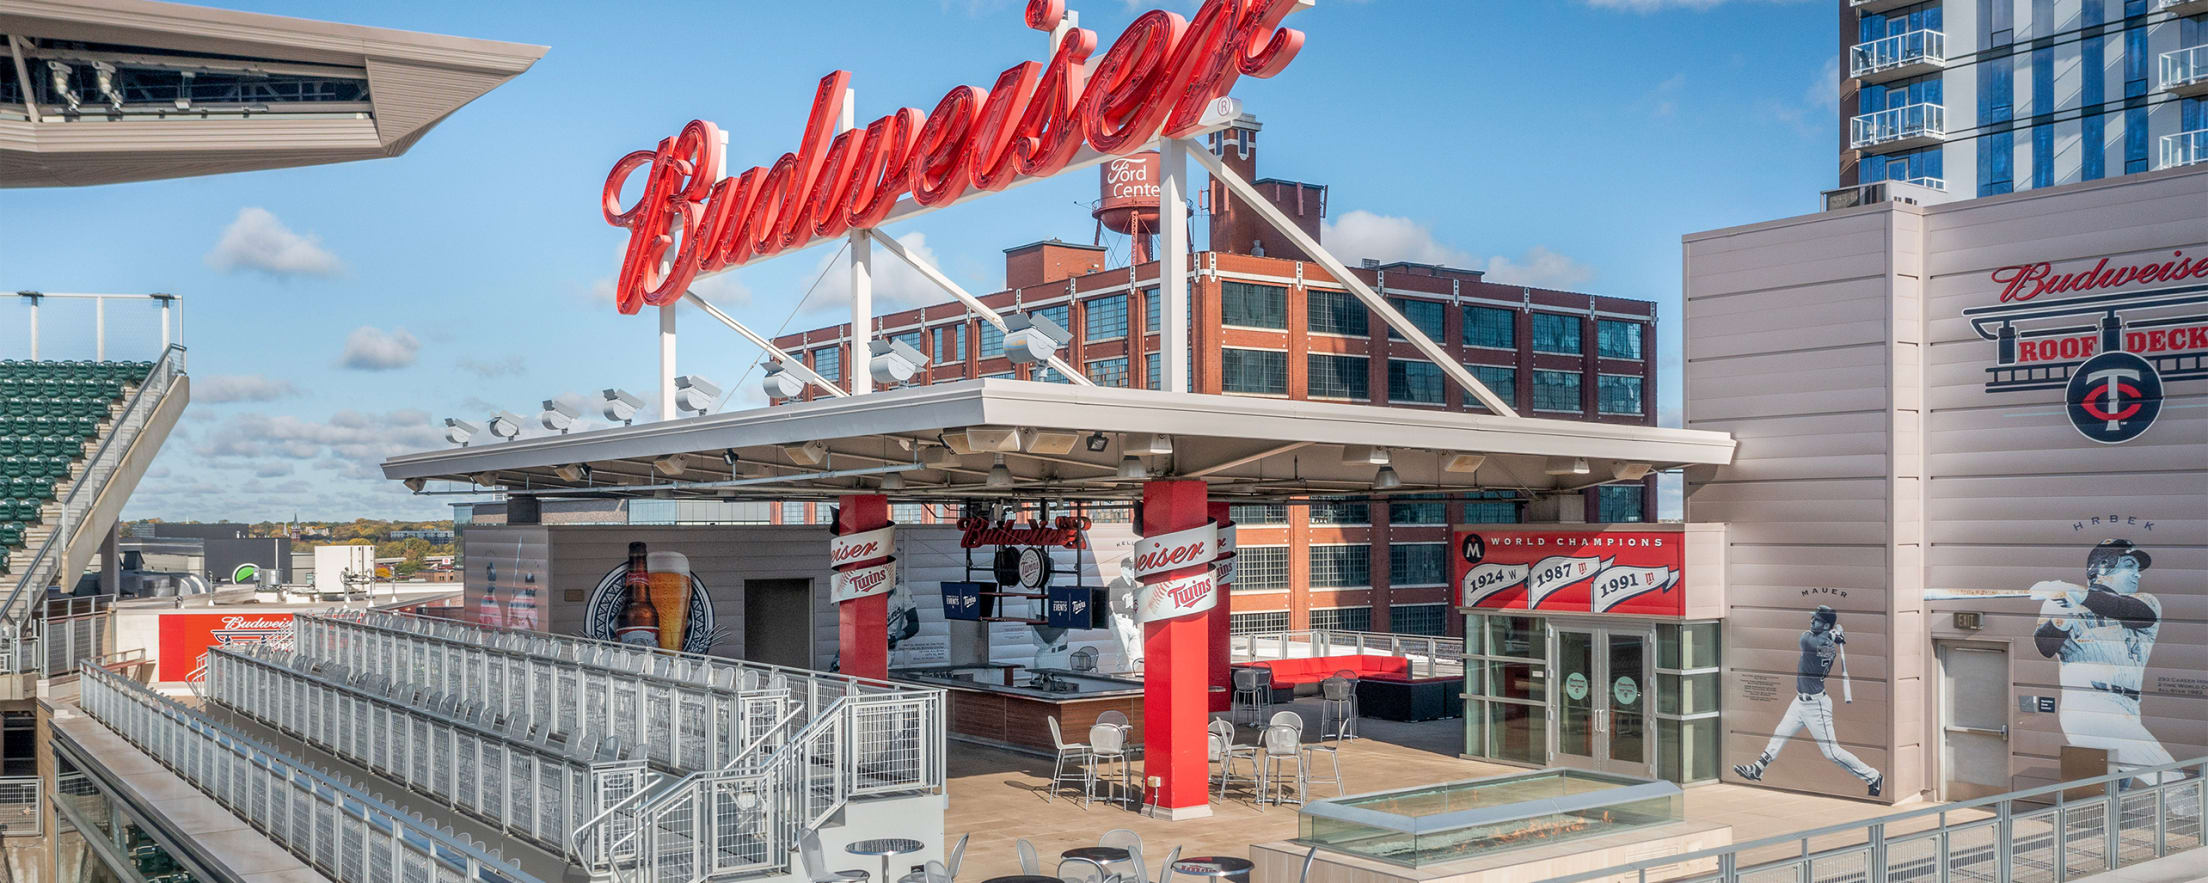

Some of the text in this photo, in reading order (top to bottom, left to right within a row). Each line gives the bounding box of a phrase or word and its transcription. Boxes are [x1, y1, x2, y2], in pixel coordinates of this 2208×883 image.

[602, 0, 1305, 314] Budweiser
[1108, 158, 1147, 184] Ford
[2018, 326, 2208, 362] ROOF DECK
[2073, 514, 2155, 531] HRBEK
[1491, 537, 1546, 546] WORLD
[1556, 537, 1663, 547] CHAMPIONS
[849, 569, 886, 593] Twins
[1470, 569, 1504, 593] 1924
[1536, 563, 1572, 587] 1987
[1601, 573, 1639, 598] 1991
[1167, 578, 1211, 609] Twins
[1801, 587, 1848, 598] MAUER
